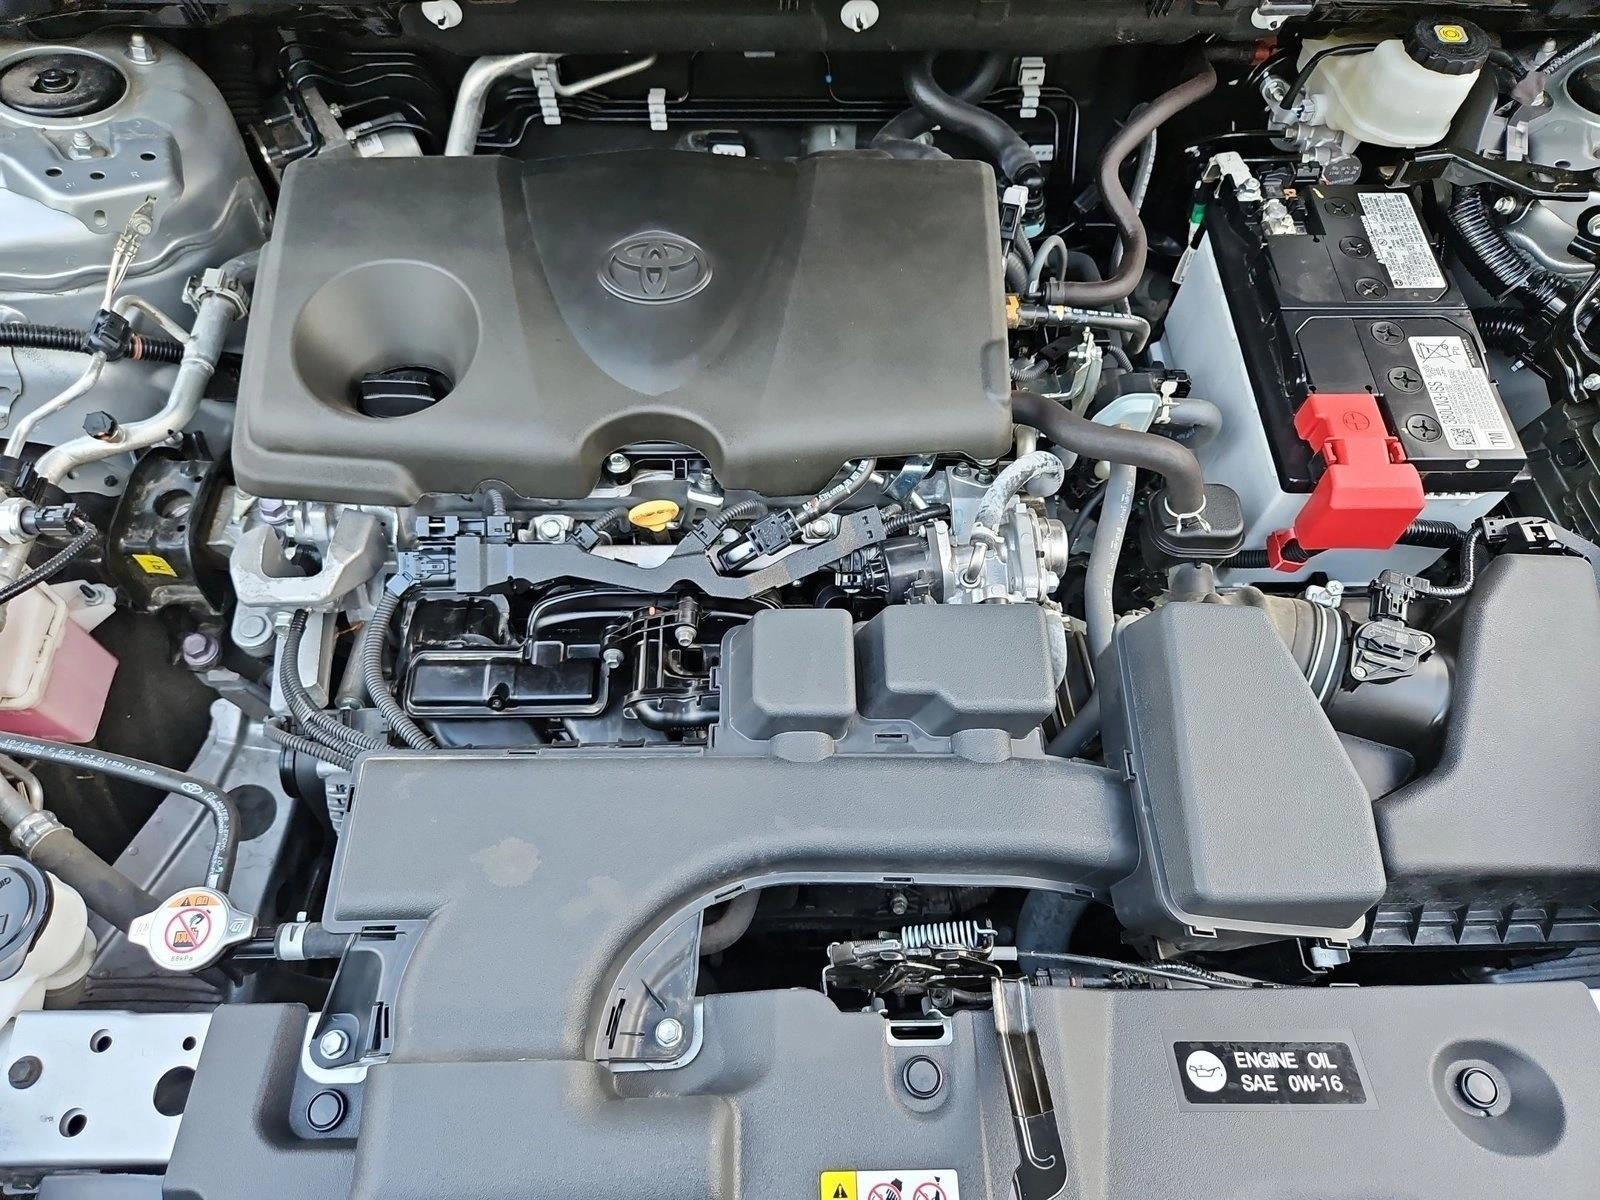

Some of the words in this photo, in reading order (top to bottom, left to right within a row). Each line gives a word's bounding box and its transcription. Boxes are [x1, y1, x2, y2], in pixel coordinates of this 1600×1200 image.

[1488, 431, 1507, 446] TM
[1233, 1051, 1299, 1069] ENGINE
[1306, 1051, 1338, 1069] OIL
[1240, 1074, 1279, 1092] SAE
[1288, 1074, 1344, 1092] 0W-16
